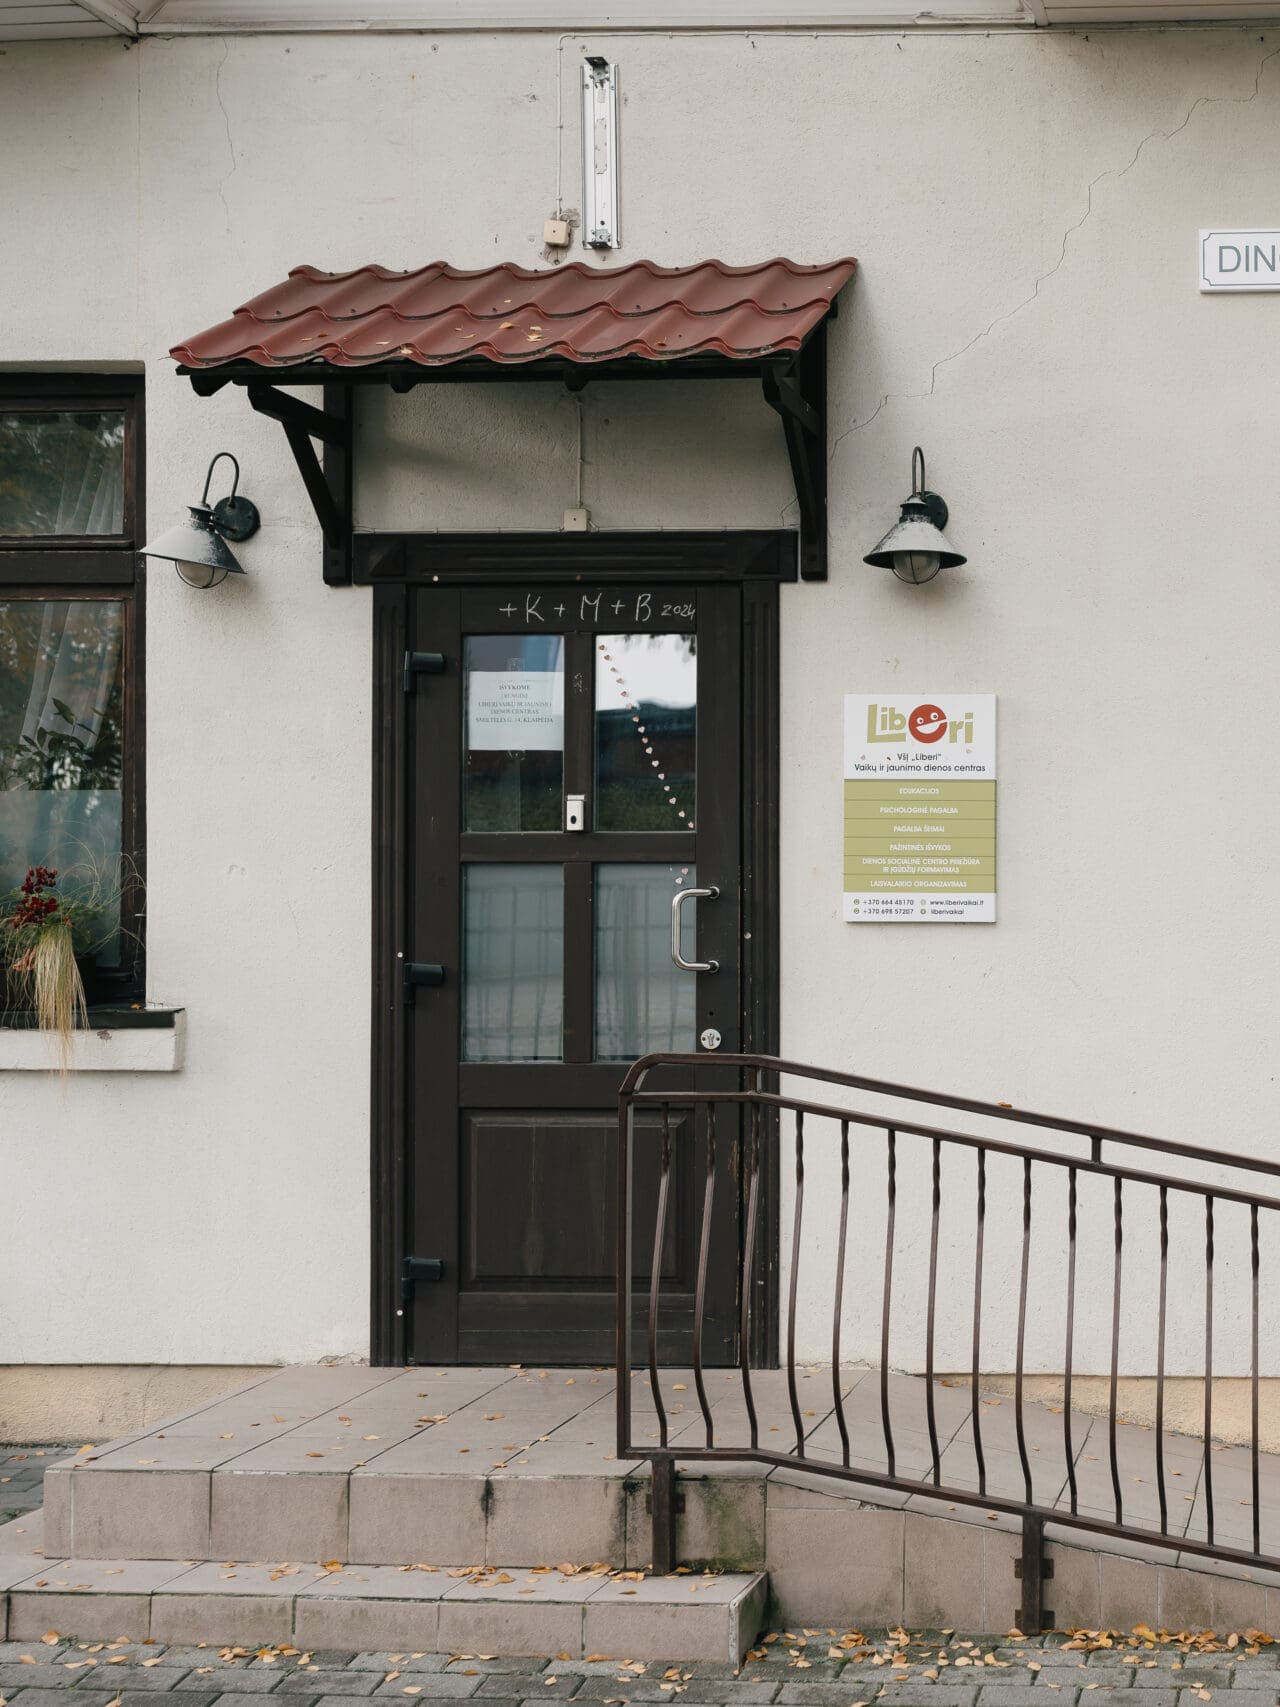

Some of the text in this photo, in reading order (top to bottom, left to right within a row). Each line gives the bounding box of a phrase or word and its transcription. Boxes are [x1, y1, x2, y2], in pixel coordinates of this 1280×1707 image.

[580, 593, 602, 623] M
[635, 593, 652, 622] B
[661, 604, 696, 621] 2024
[880, 763, 885, 772] ir
[886, 763, 921, 773] jaunimo
[924, 763, 952, 772] dienos
[954, 763, 986, 772] centras
[930, 806, 959, 814] PAGALBA
